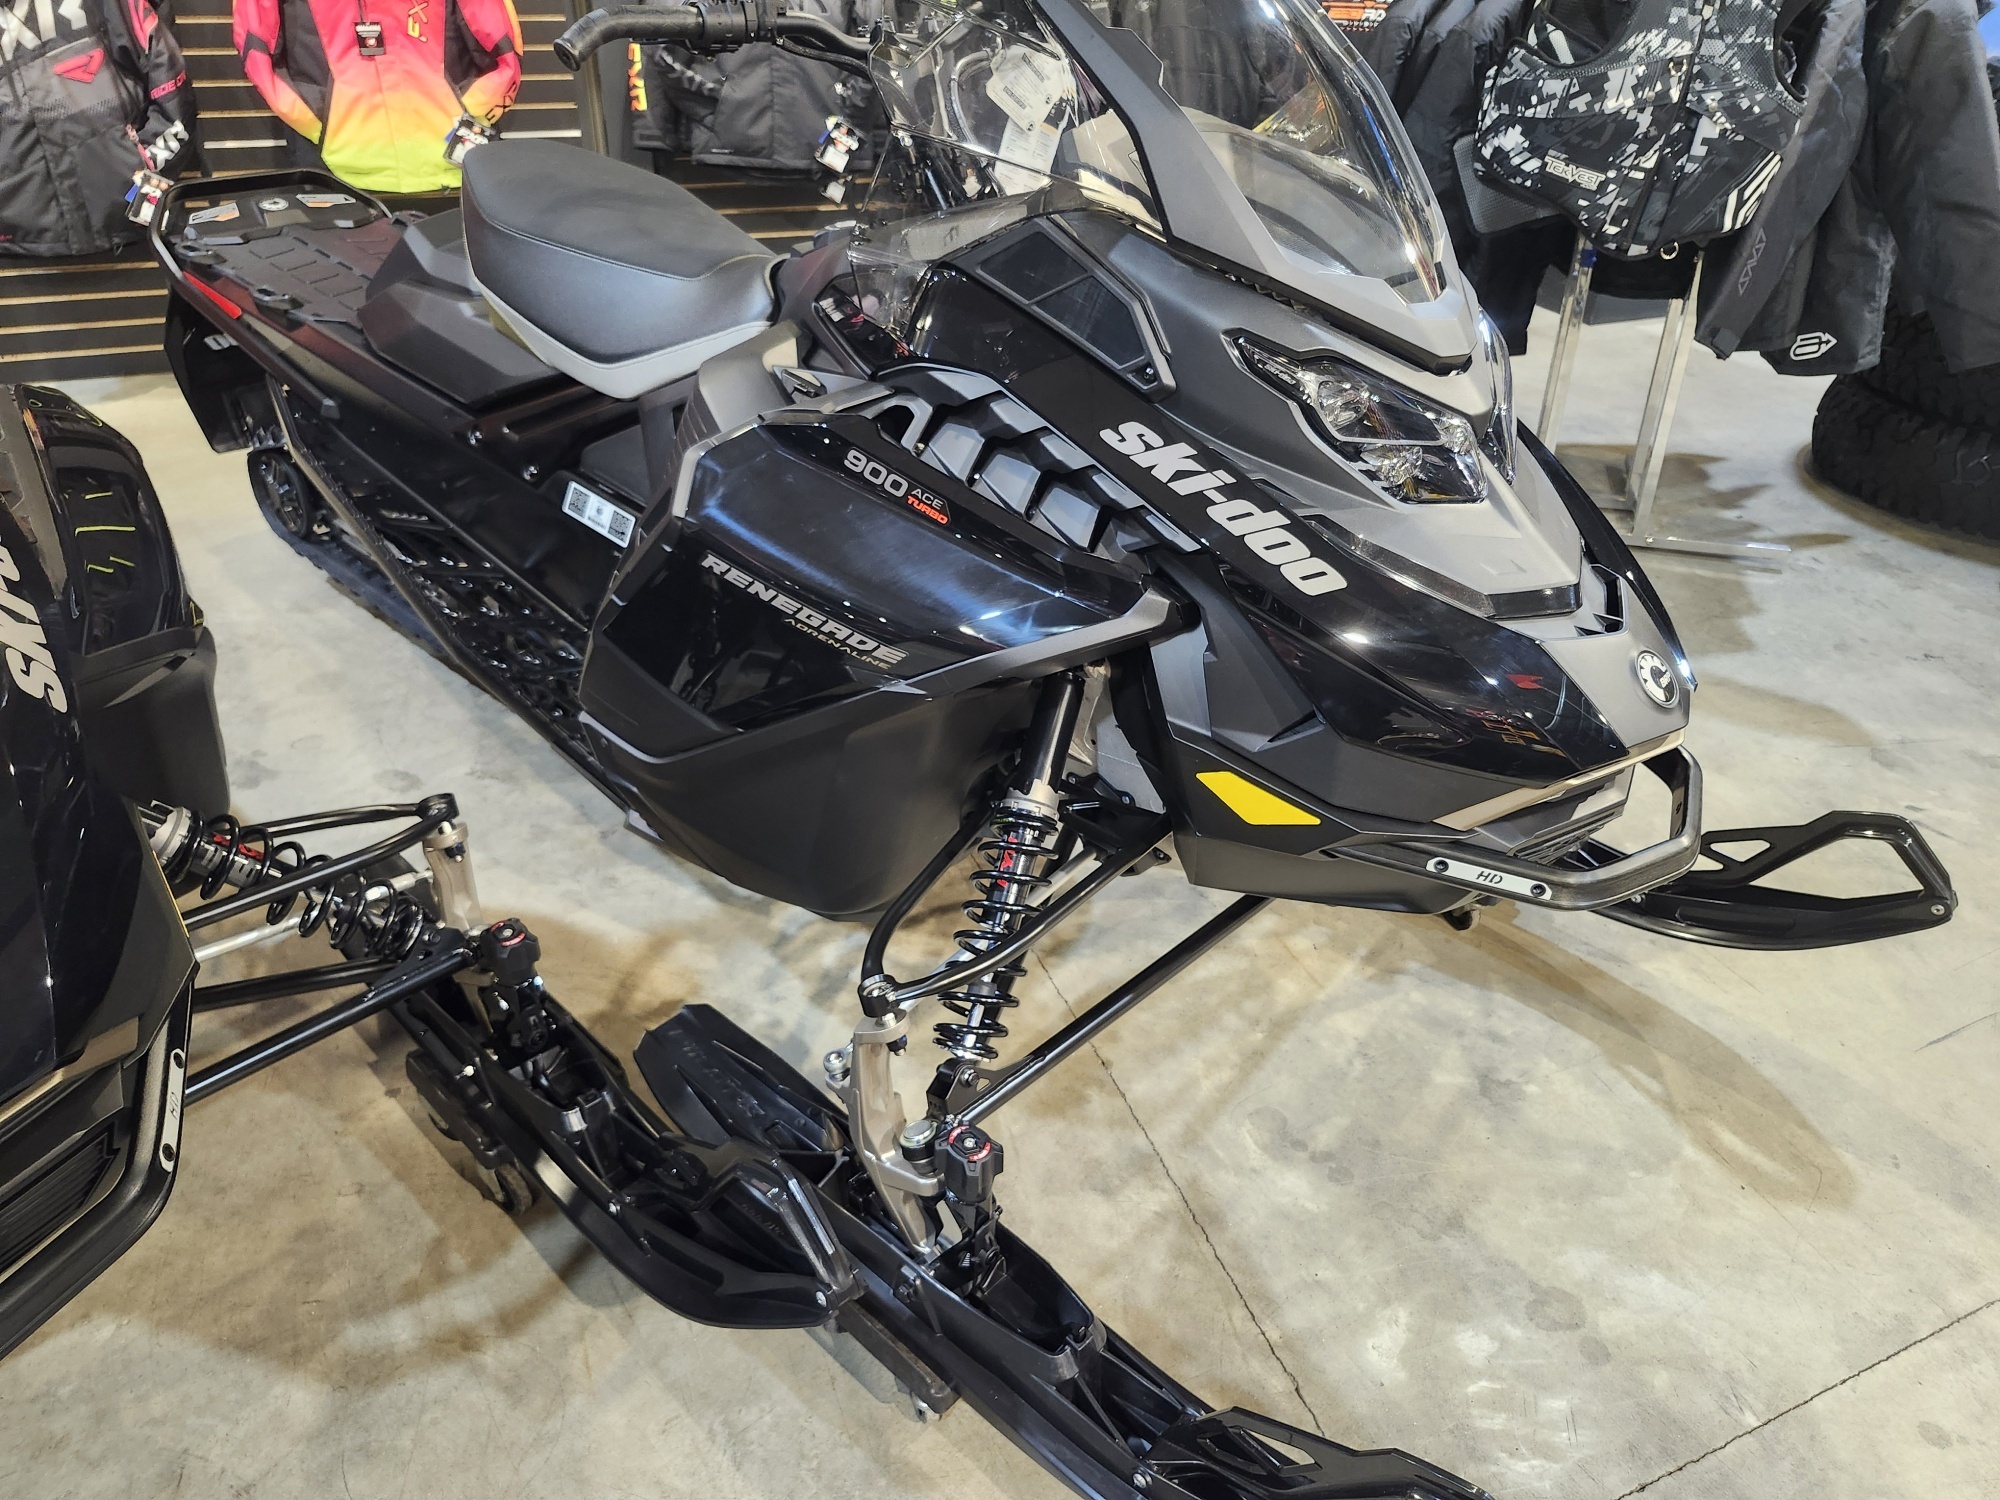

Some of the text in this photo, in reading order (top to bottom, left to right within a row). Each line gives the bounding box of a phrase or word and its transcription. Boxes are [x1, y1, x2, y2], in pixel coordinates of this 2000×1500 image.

[628, 43, 648, 111] FXR
[843, 449, 944, 510] 900 ACE
[907, 495, 949, 525] TURBO
[1099, 421, 1348, 597] ski-doo
[701, 553, 908, 664] RENEGADE
[783, 618, 892, 670] ADRENALINE
[1475, 870, 1504, 885] HD
